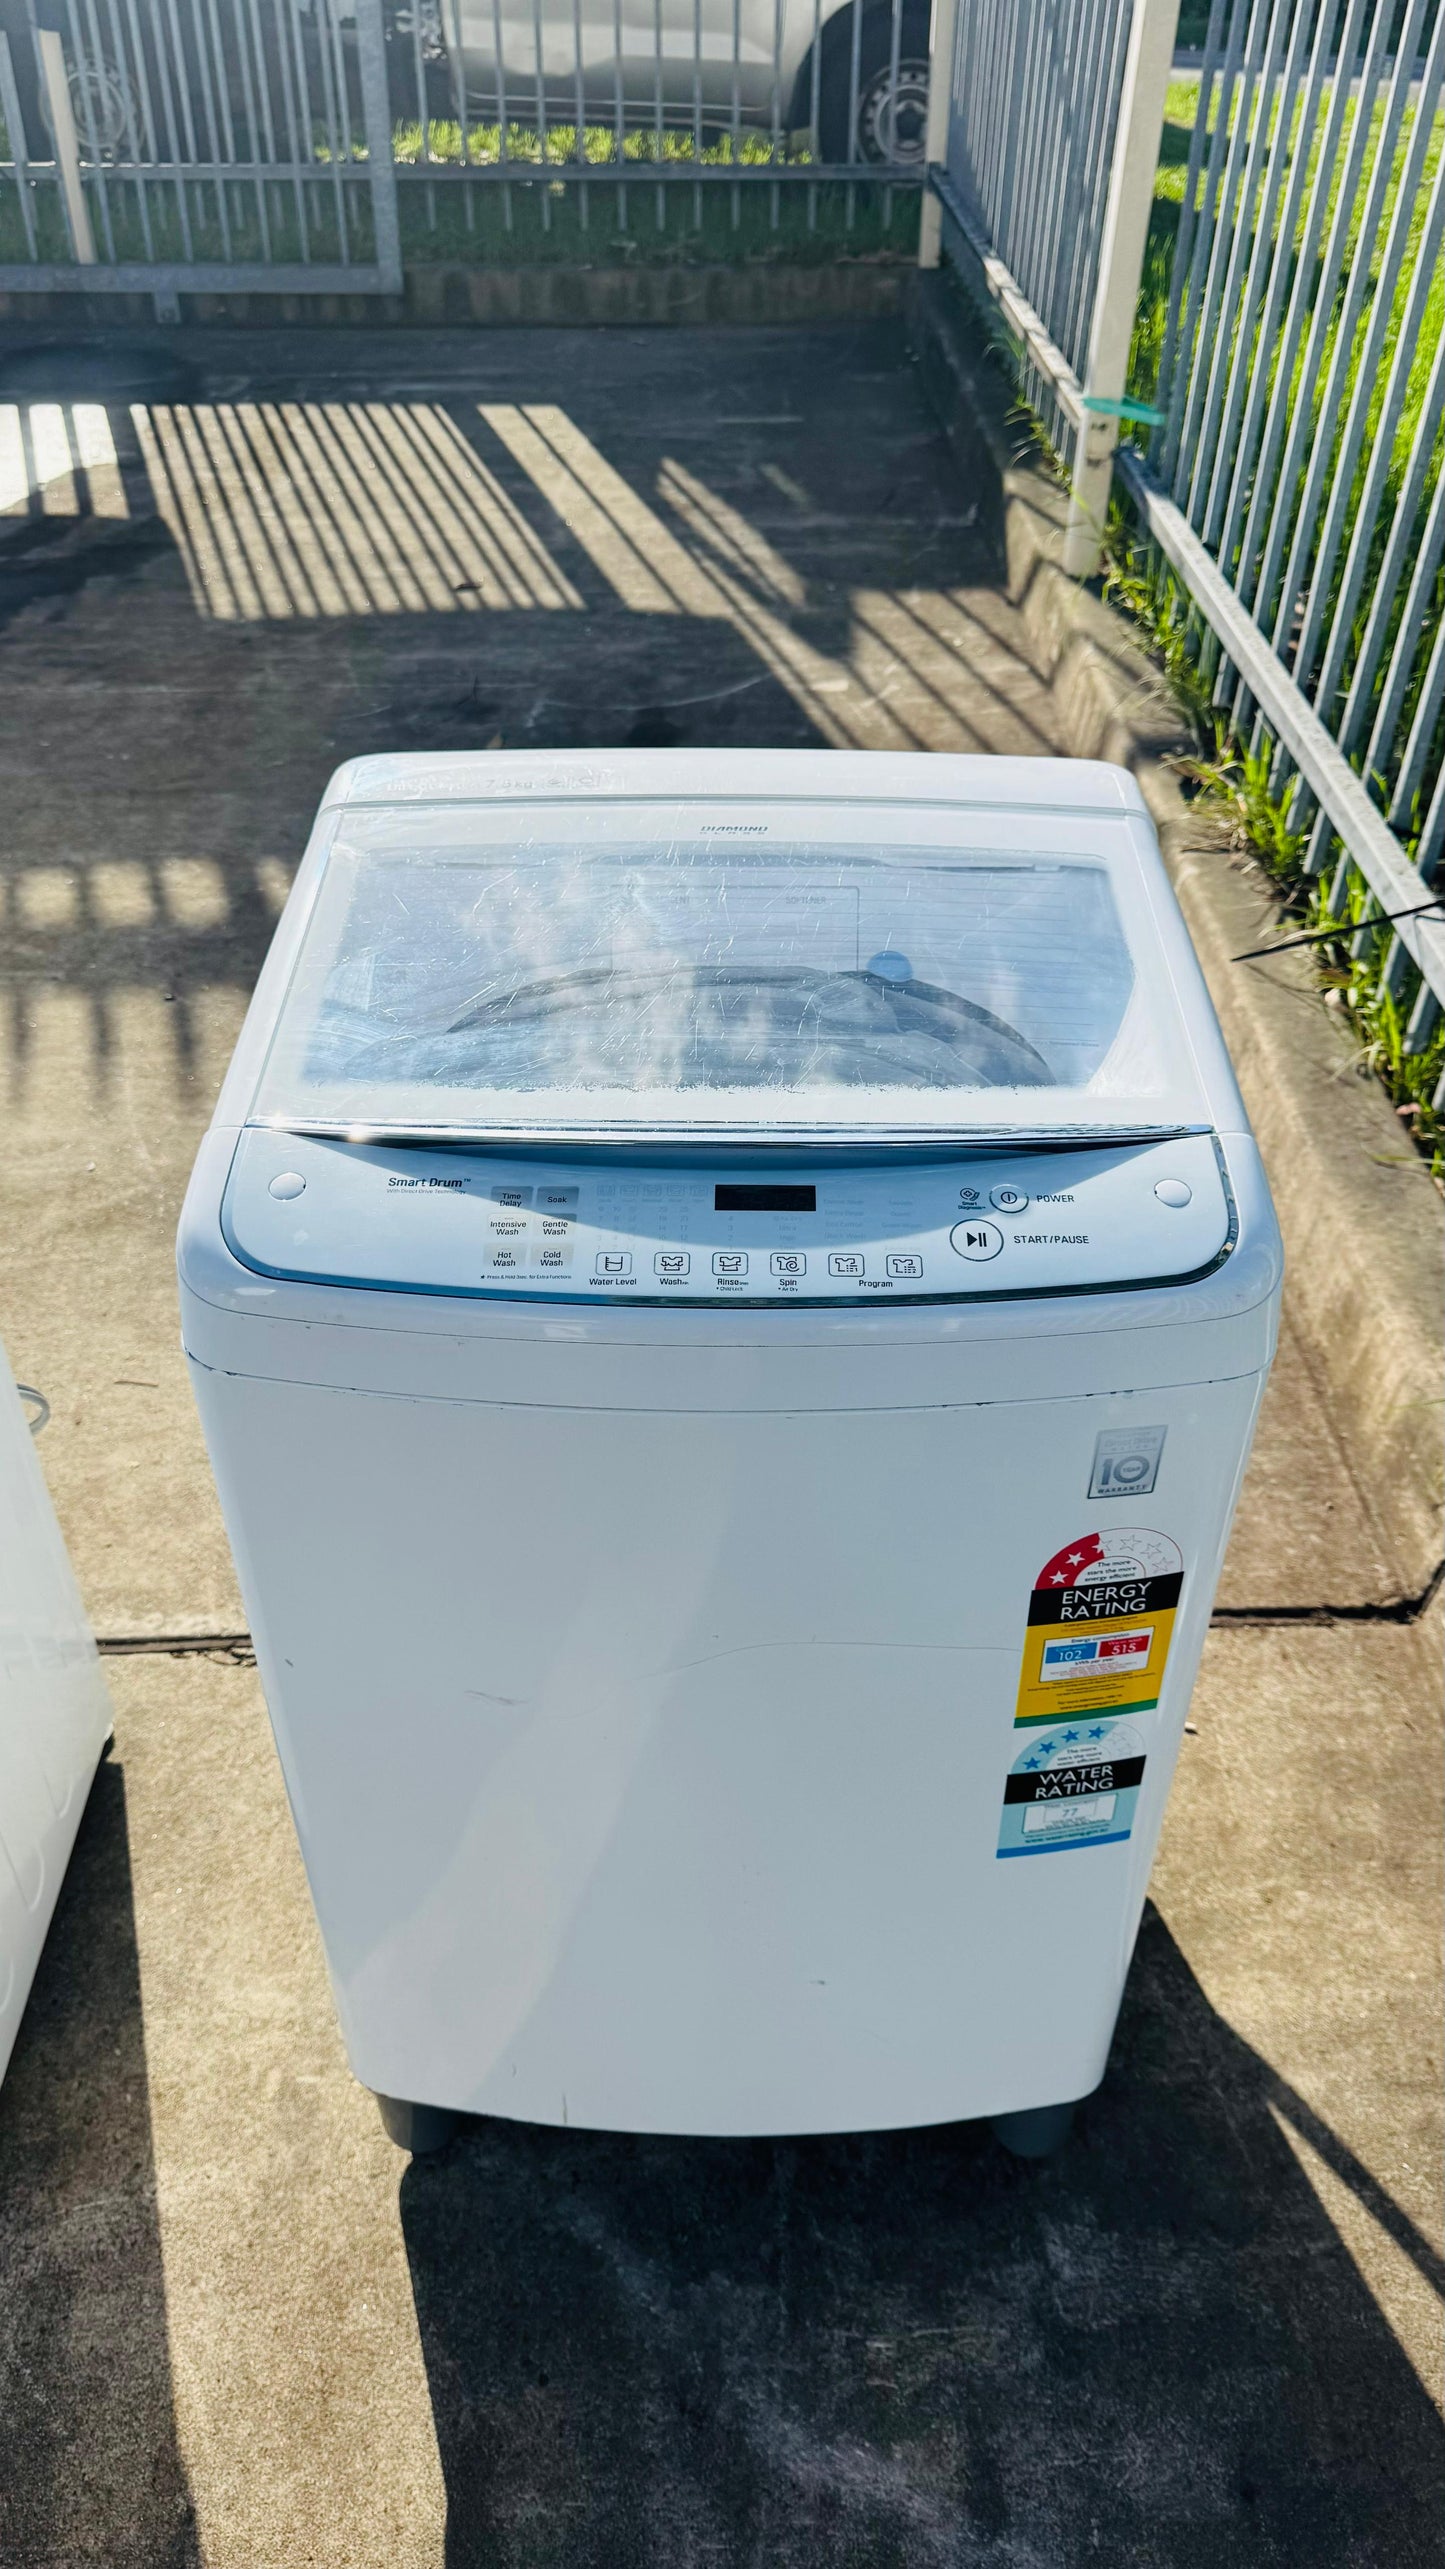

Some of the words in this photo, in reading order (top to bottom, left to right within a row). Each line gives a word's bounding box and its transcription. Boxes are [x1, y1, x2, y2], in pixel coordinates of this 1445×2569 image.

[388, 1177, 427, 1187] Smart
[502, 1192, 522, 1200] Time
[547, 1195, 568, 1204] Soak
[1036, 1194, 1075, 1203] POWER
[499, 1199, 523, 1208] Delay
[489, 1220, 528, 1228] Intensive
[542, 1220, 569, 1228] Gentle
[496, 1228, 519, 1236] Wash
[543, 1228, 567, 1236] Wash
[1013, 1235, 1090, 1244] START/PAUSE
[497, 1251, 512, 1259] Hot
[543, 1251, 561, 1259] Cold
[492, 1259, 516, 1267] Wash
[540, 1259, 564, 1267] Wash
[588, 1278, 614, 1286] Water
[615, 1278, 637, 1286] Level
[659, 1278, 682, 1286] Wash
[717, 1278, 740, 1286] Rinse
[779, 1278, 798, 1287] Spin
[858, 1279, 893, 1289] Program
[1101, 1455, 1150, 1485] 10
[1098, 1485, 1147, 1494] WARRANTY
[1109, 1572, 1135, 1580] efficient
[1062, 1581, 1152, 1604] ENERGY
[1060, 1598, 1147, 1620] RATING
[1092, 1632, 1130, 1642] consumption
[1111, 1642, 1137, 1655] 515
[1059, 1651, 1082, 1661] 102
[1040, 1764, 1114, 1785] WATER
[1035, 1777, 1114, 1799] RATING
[1062, 1807, 1079, 1818] 77
